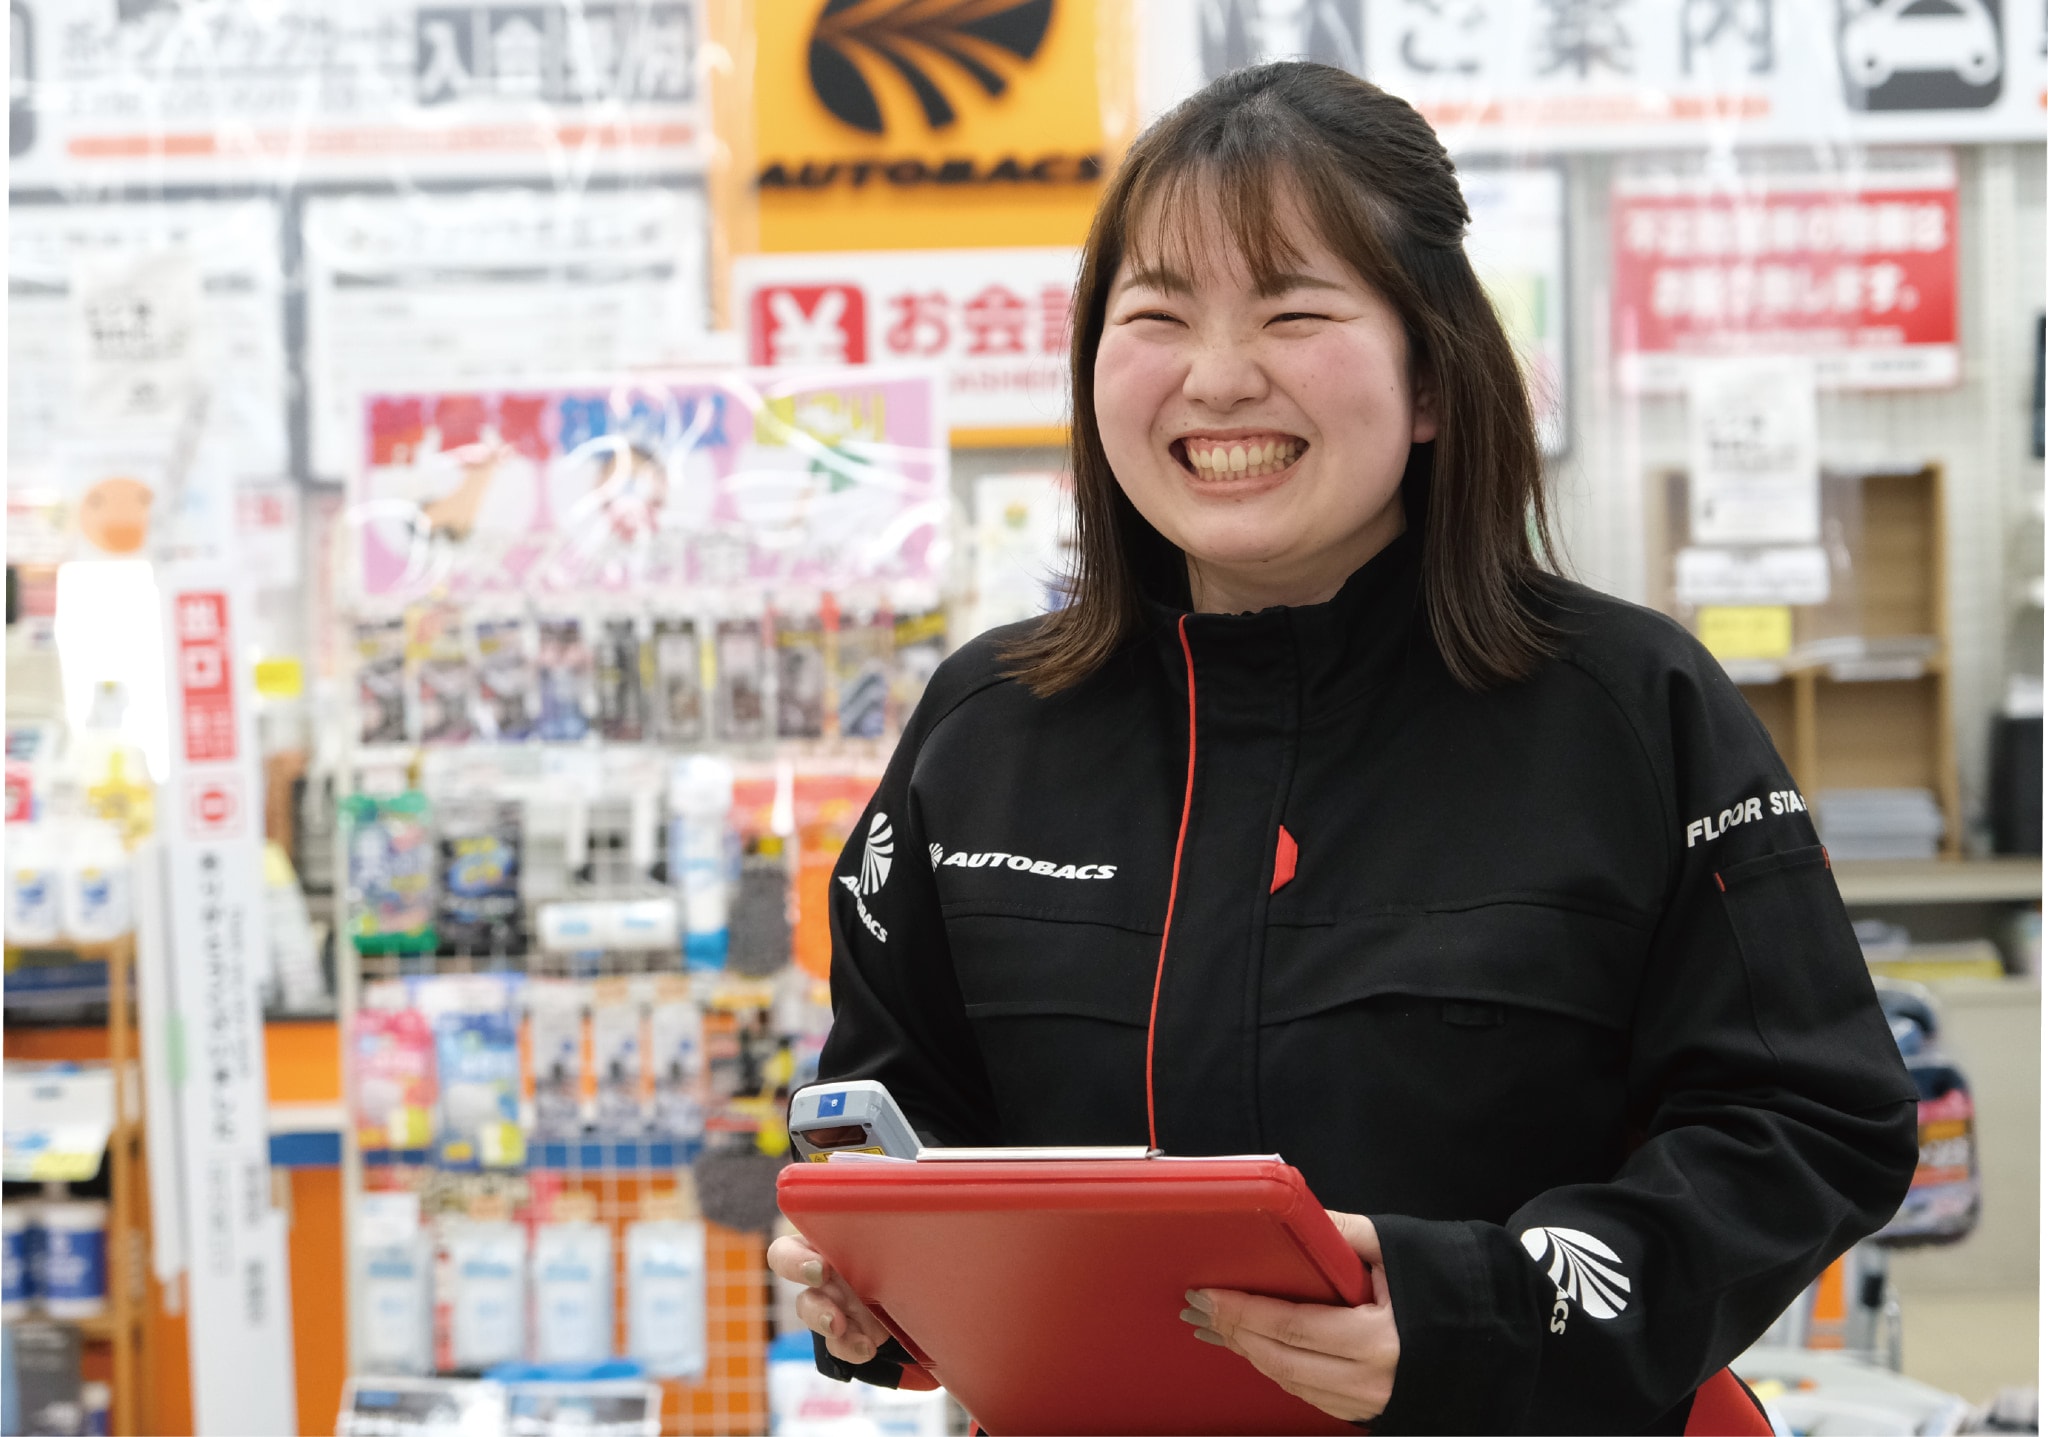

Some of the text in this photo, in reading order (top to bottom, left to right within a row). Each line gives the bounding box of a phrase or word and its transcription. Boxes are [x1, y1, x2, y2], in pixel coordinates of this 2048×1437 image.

[757, 154, 1103, 193] AUTOBACS
[1687, 797, 1763, 848] FLOOR
[943, 851, 1118, 880] AUTOBACS
